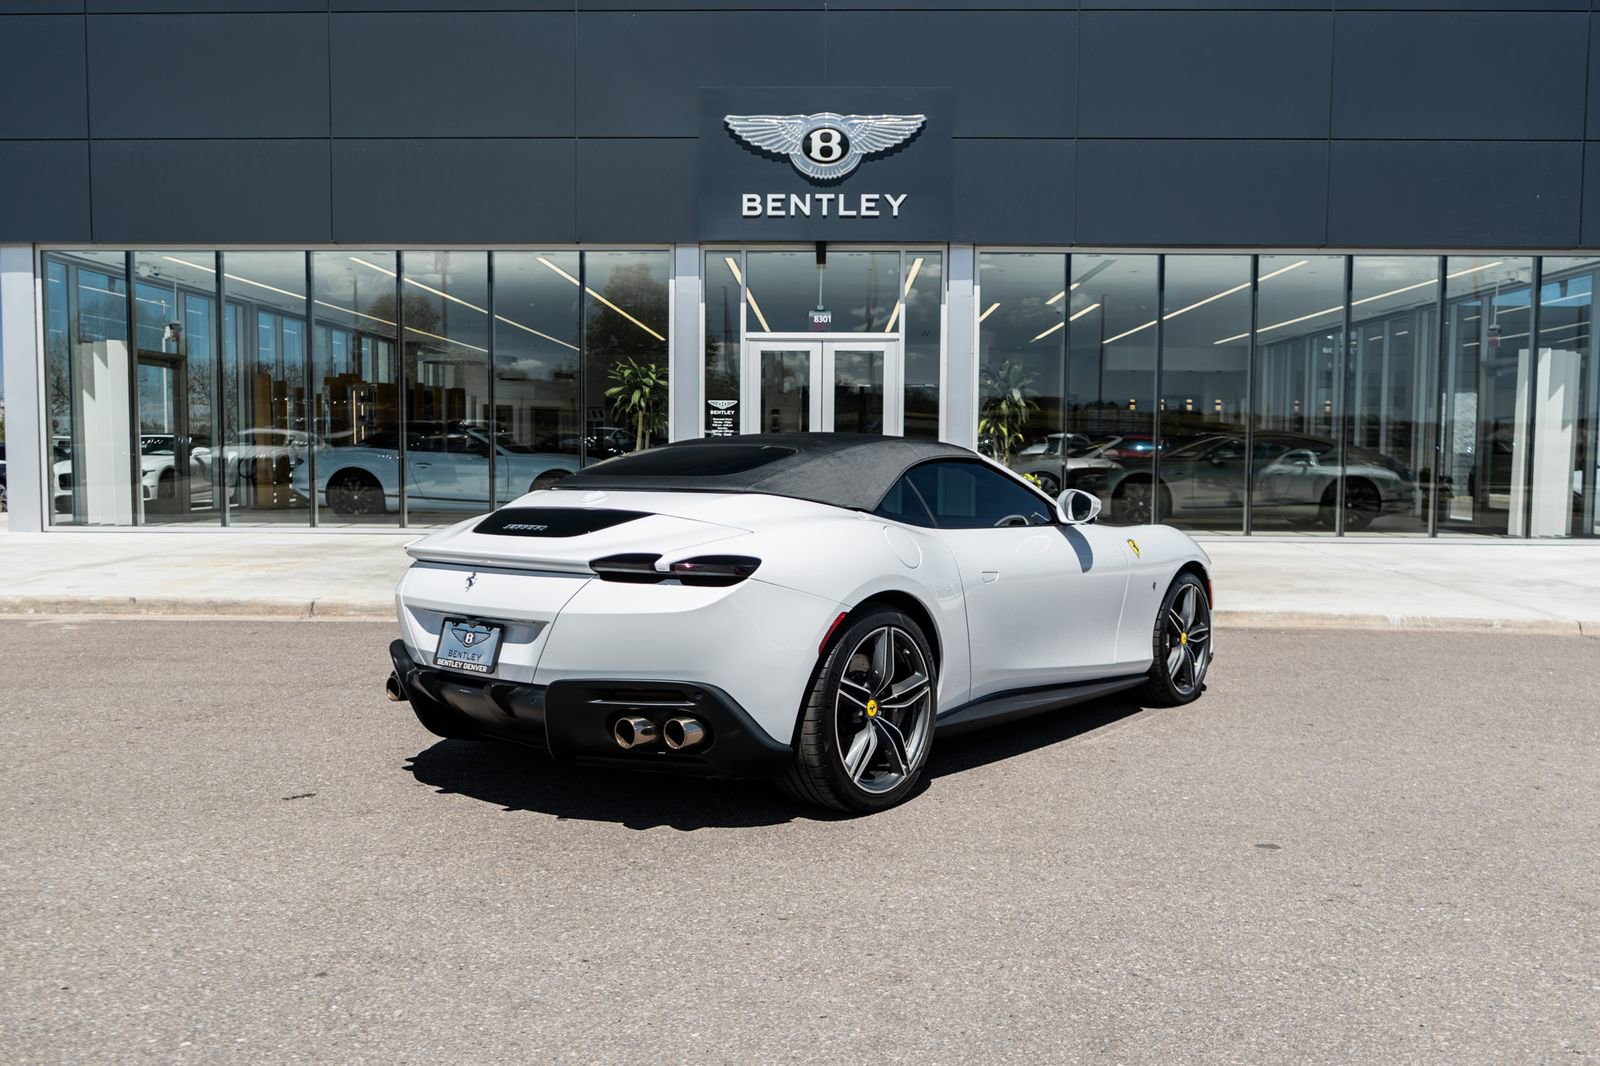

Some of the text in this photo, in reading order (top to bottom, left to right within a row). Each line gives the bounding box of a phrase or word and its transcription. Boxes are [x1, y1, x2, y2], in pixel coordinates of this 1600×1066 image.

[809, 128, 842, 162] B
[742, 193, 908, 217] BENTLEY
[813, 315, 832, 323] 8301
[448, 649, 483, 662] BENTLEY
[437, 658, 488, 673] BENTLEY DENVER
